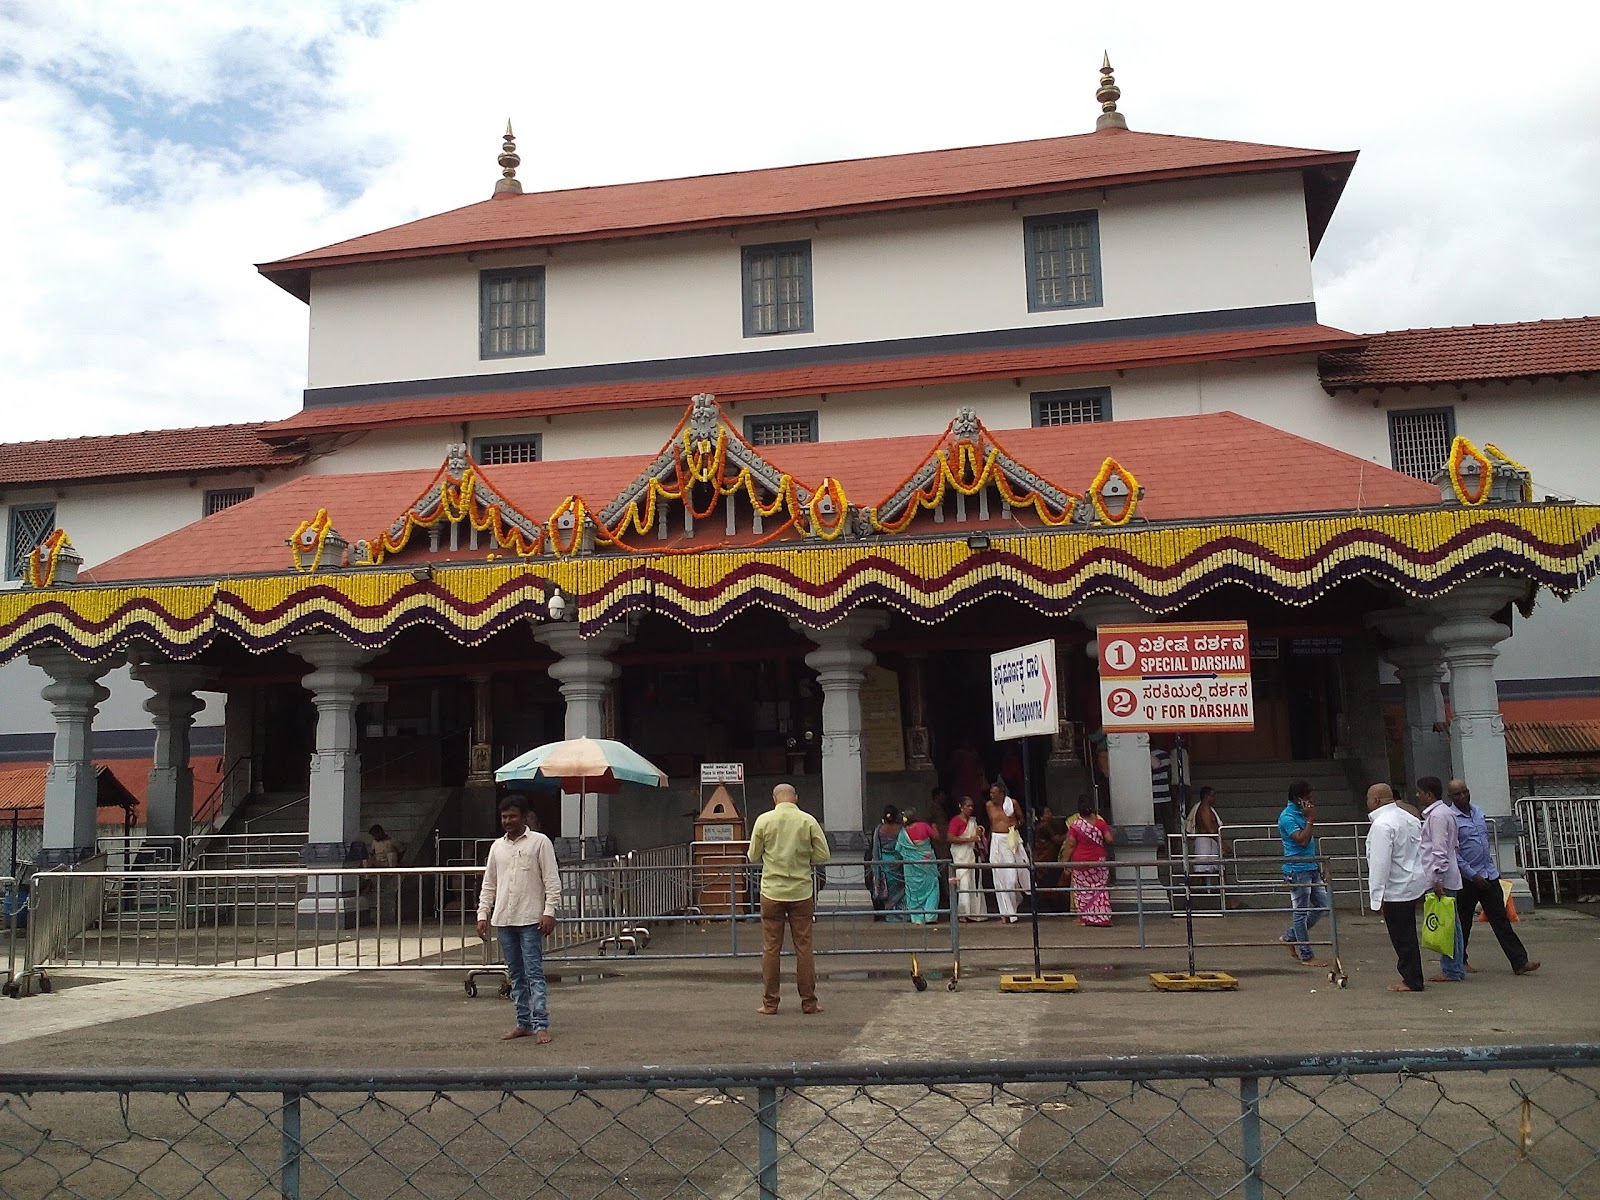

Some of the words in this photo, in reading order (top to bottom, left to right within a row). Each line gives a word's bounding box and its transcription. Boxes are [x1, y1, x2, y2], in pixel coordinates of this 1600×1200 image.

[1138, 635, 1190, 653] ವಿಶೇಷ
[1194, 634, 1245, 651] ದರ್ಶನ
[1113, 644, 1127, 665] 1
[1140, 656, 1188, 673] SPECIAL
[1191, 655, 1246, 671] DARSHAN
[1112, 691, 1132, 713] 2
[1142, 682, 1208, 703] ಸರತಿಯಲ್ಲಿ
[1208, 681, 1249, 698] ದರ್ಶನ
[995, 701, 1006, 732] Way
[1006, 701, 1012, 724] to
[1143, 704, 1158, 721] 'Q'
[1161, 704, 1187, 719] FOR
[1190, 703, 1249, 719] DARSHAN
